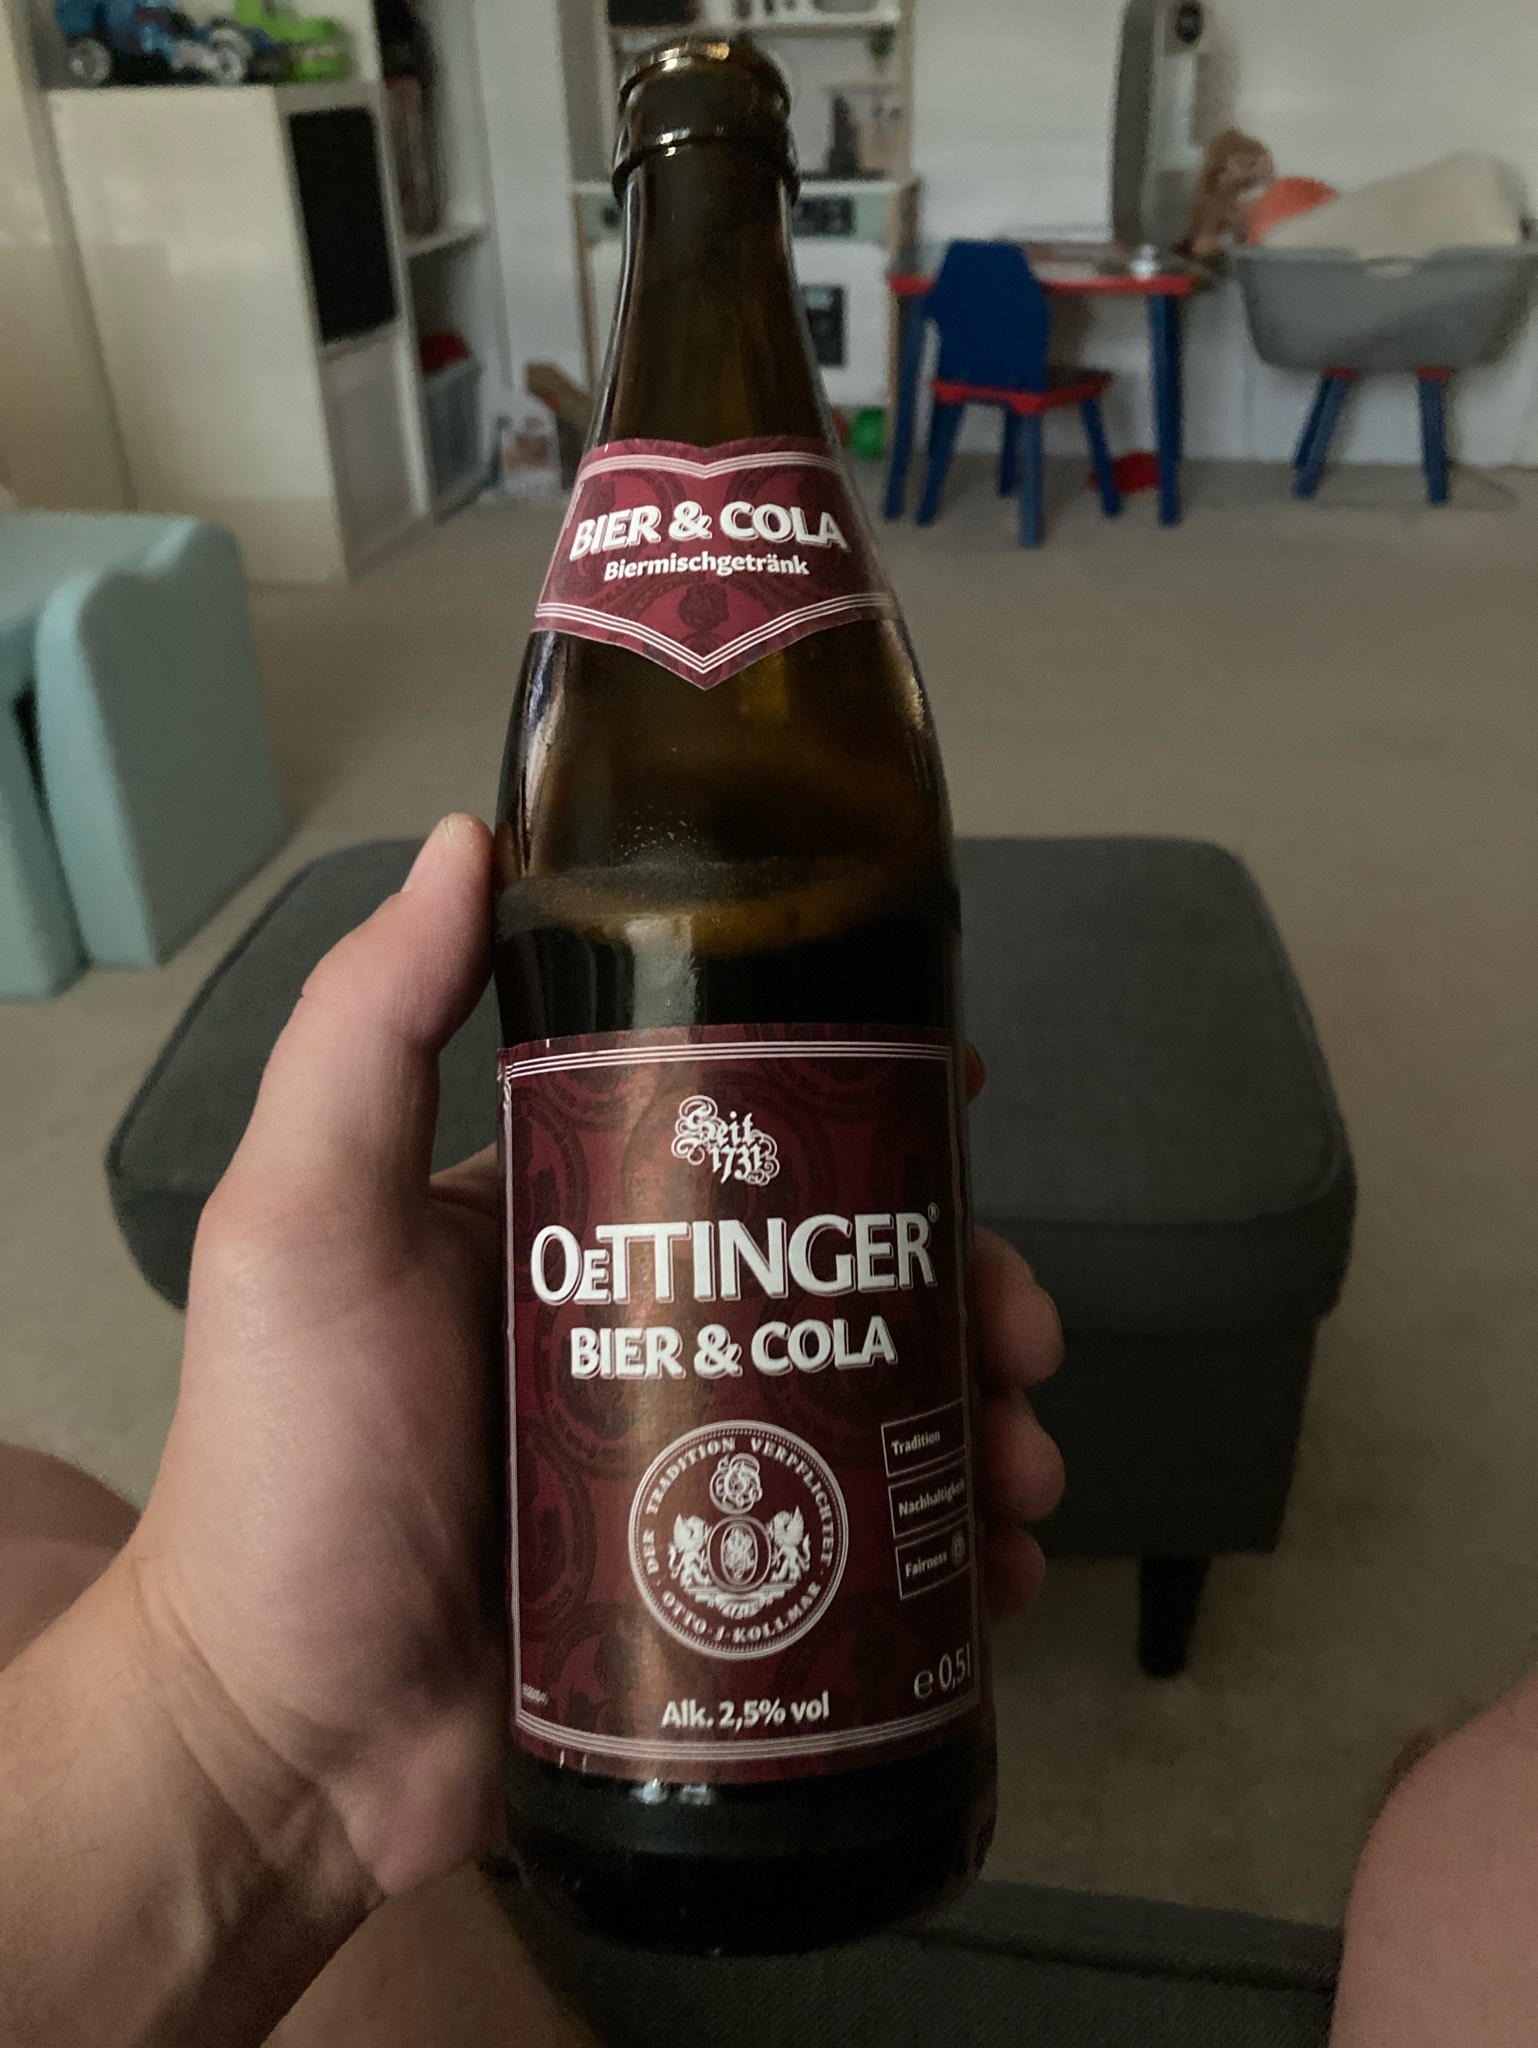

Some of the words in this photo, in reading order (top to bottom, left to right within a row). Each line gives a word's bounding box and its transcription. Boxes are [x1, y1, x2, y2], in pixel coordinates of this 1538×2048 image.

[570, 505, 661, 560] BIER
[668, 501, 712, 541] &
[719, 501, 851, 552] COLA
[603, 550, 810, 581] Biermischgetränk
[671, 1095, 756, 1166] Seit
[570, 1327, 686, 1379] BIER
[693, 1324, 743, 1377] &
[750, 1316, 899, 1376] COLA
[891, 1430, 941, 1456] Tradition
[646, 1437, 736, 1515] TRADITION
[751, 1436, 835, 1567] VERPFLICHTET
[643, 1529, 659, 1575] DER
[905, 1551, 948, 1578] Fairness
[661, 1698, 715, 1728] Alk.
[718, 1697, 787, 1732] 2,5%
[790, 1689, 830, 1723] vol
